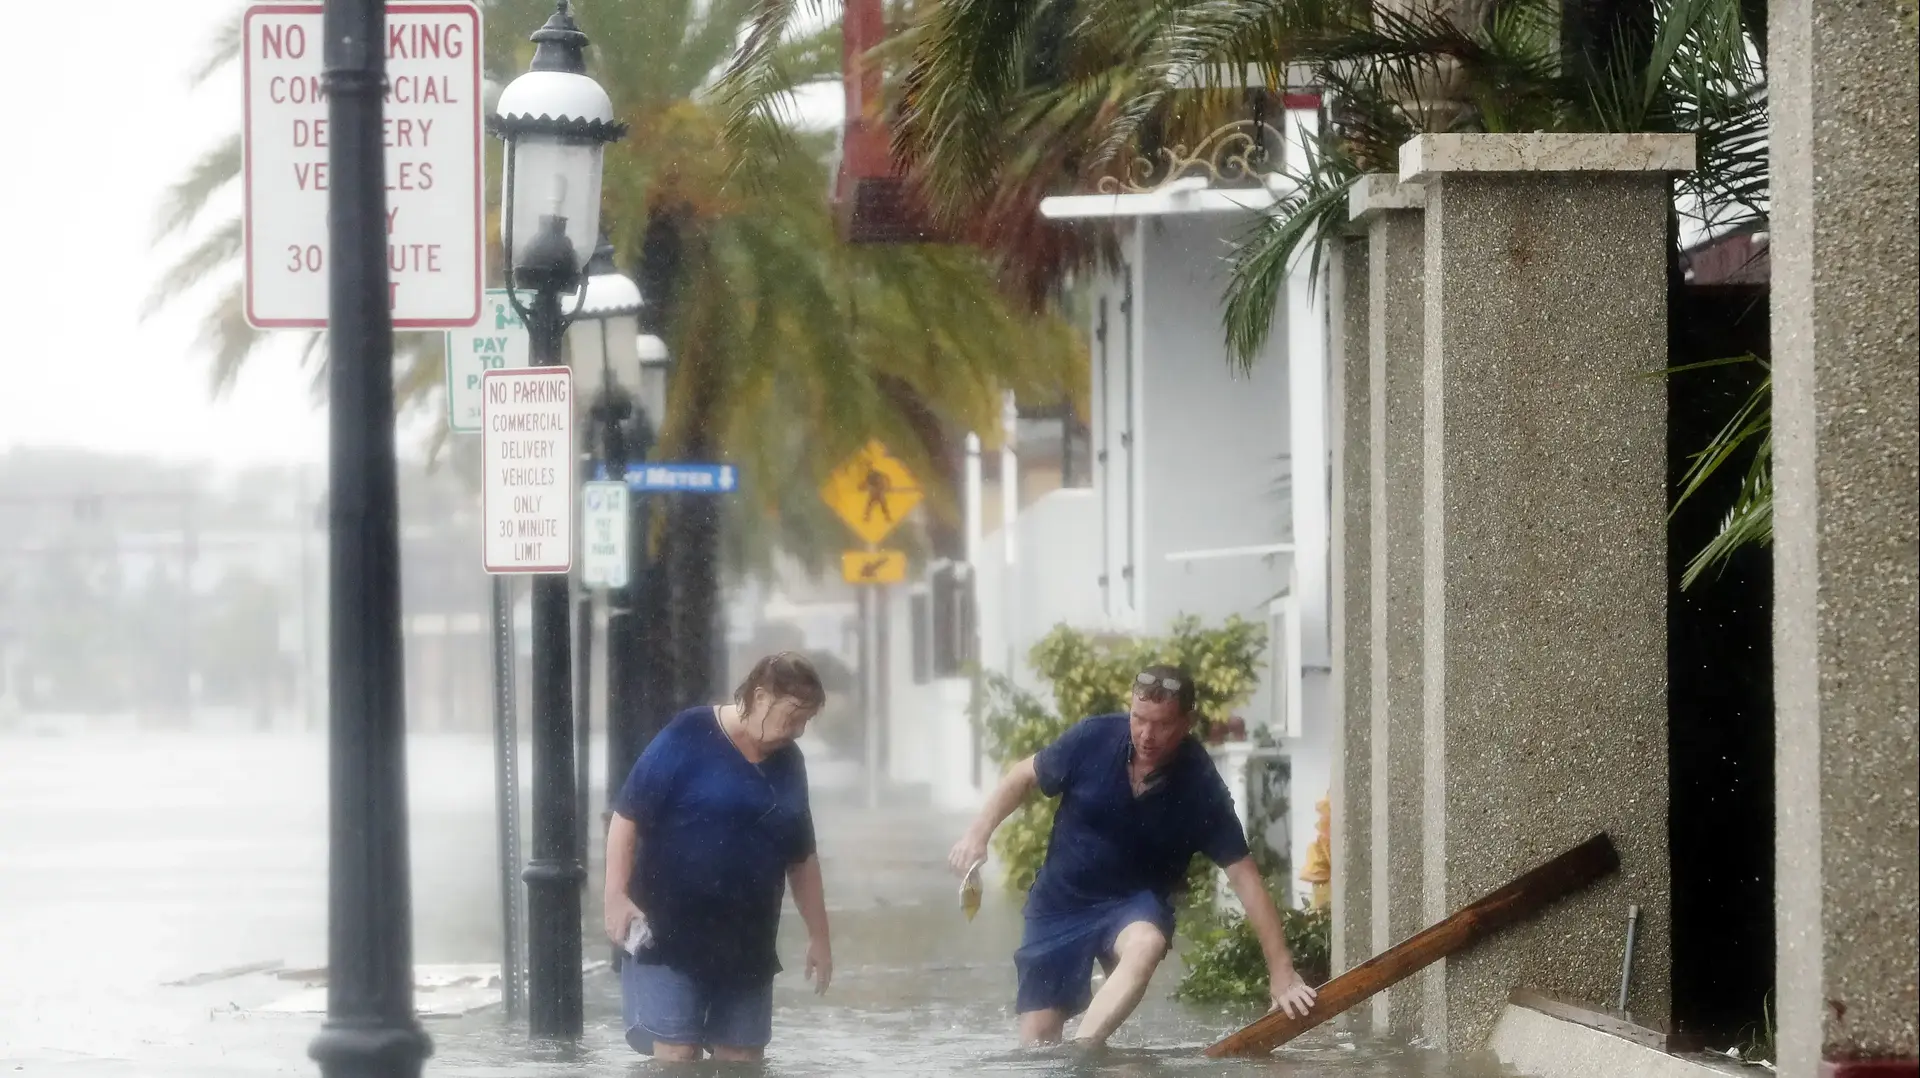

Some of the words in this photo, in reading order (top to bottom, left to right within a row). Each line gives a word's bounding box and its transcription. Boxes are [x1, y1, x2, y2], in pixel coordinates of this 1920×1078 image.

[262, 24, 305, 59] NO
[386, 24, 463, 59] KING
[270, 75, 458, 104] COMCIAL
[293, 119, 433, 147] DEERY
[294, 162, 433, 190] VEES
[287, 244, 322, 273] 30
[389, 244, 441, 273] UTE
[473, 337, 508, 353] PAY
[479, 355, 505, 370] TO
[490, 382, 507, 404] NO
[513, 380, 566, 404] PARKING
[492, 412, 564, 433] COMMERCIAL
[501, 440, 555, 460] DELIVERY
[502, 467, 555, 487] VEHICLES
[514, 495, 542, 514] ONLY
[499, 520, 513, 538] 30
[518, 519, 557, 538] MINUTE
[514, 542, 542, 561] LIMIT
